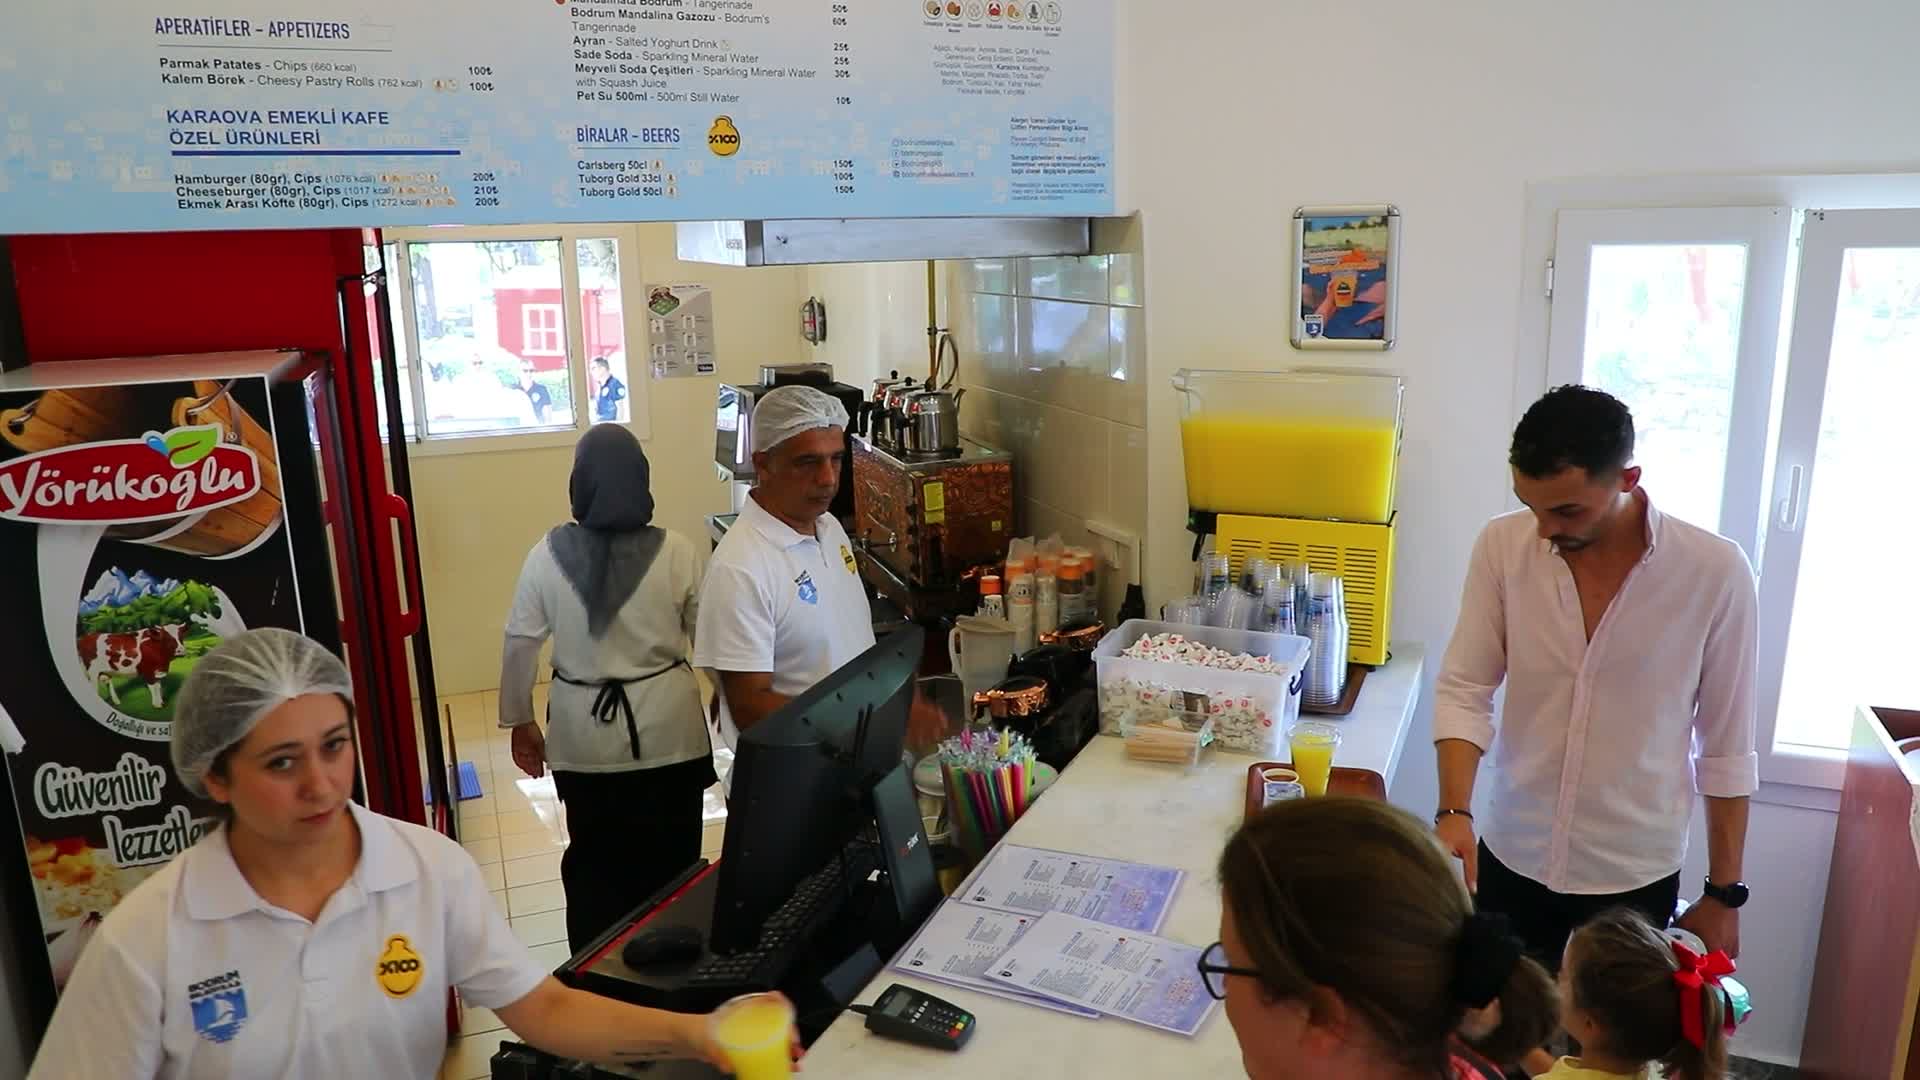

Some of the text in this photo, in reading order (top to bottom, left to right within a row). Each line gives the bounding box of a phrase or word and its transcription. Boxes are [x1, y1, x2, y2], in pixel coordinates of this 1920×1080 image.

[571, 8, 615, 18] Bodrum
[618, 9, 673, 20] Mandalina
[676, 12, 715, 22] Gazozu
[724, 13, 770, 24] Bodrum's
[154, 16, 251, 38] APERATİFLER
[268, 21, 350, 39] APPETIZERS
[572, 22, 636, 33] Tangerinade
[573, 36, 606, 47] Ayran
[616, 37, 648, 47] Salted
[650, 38, 689, 49] Yoghurt
[692, 39, 718, 49] Drink
[574, 50, 601, 60] Sade
[605, 50, 632, 60] Soda
[642, 51, 688, 63] Sparkling
[691, 53, 728, 63] Mineral
[730, 54, 759, 63] Water
[159, 58, 209, 69] Parmak
[213, 59, 261, 71] Patates
[272, 59, 308, 72] Chips
[333, 62, 357, 74] kcal)
[575, 64, 616, 76] Meyveli
[619, 64, 647, 75] Soda
[650, 65, 693, 77] Çeşitleri
[703, 66, 748, 78] Sparkling
[750, 67, 786, 77] Mineral
[788, 68, 816, 78] Water
[162, 74, 204, 86] Kalem
[207, 74, 246, 86] Börek
[257, 75, 301, 88] Cheesy
[305, 76, 343, 88] Pastry
[346, 76, 375, 87] Rolls
[401, 78, 423, 89] kcal)
[576, 78, 667, 89] with Squash Juice
[577, 91, 595, 101] Pet
[598, 91, 613, 101] Su
[616, 92, 647, 102] 500ml
[657, 92, 687, 102] 500ml
[690, 93, 708, 102] Still
[710, 93, 740, 103] Water
[167, 108, 389, 125] KARAOVA EMEKLİ KAFE
[169, 128, 321, 146] ÖZEL ÜRÜNLERİ
[577, 124, 628, 143] BİRALAR
[642, 128, 680, 143] BEERS
[577, 160, 647, 171] Carlsberg 50cl
[175, 173, 247, 187] Hamburger
[294, 173, 322, 185] Cips
[579, 174, 661, 185] Tuborg Gold 33cl
[176, 185, 267, 198] Cheeseburger
[312, 185, 341, 197] Cips
[580, 187, 662, 198] Tuborg Gold 50cl
[178, 198, 222, 210] Ekmek
[225, 198, 258, 210] Arası
[341, 197, 369, 208] Cips
[40, 756, 162, 813] Güvenilir
